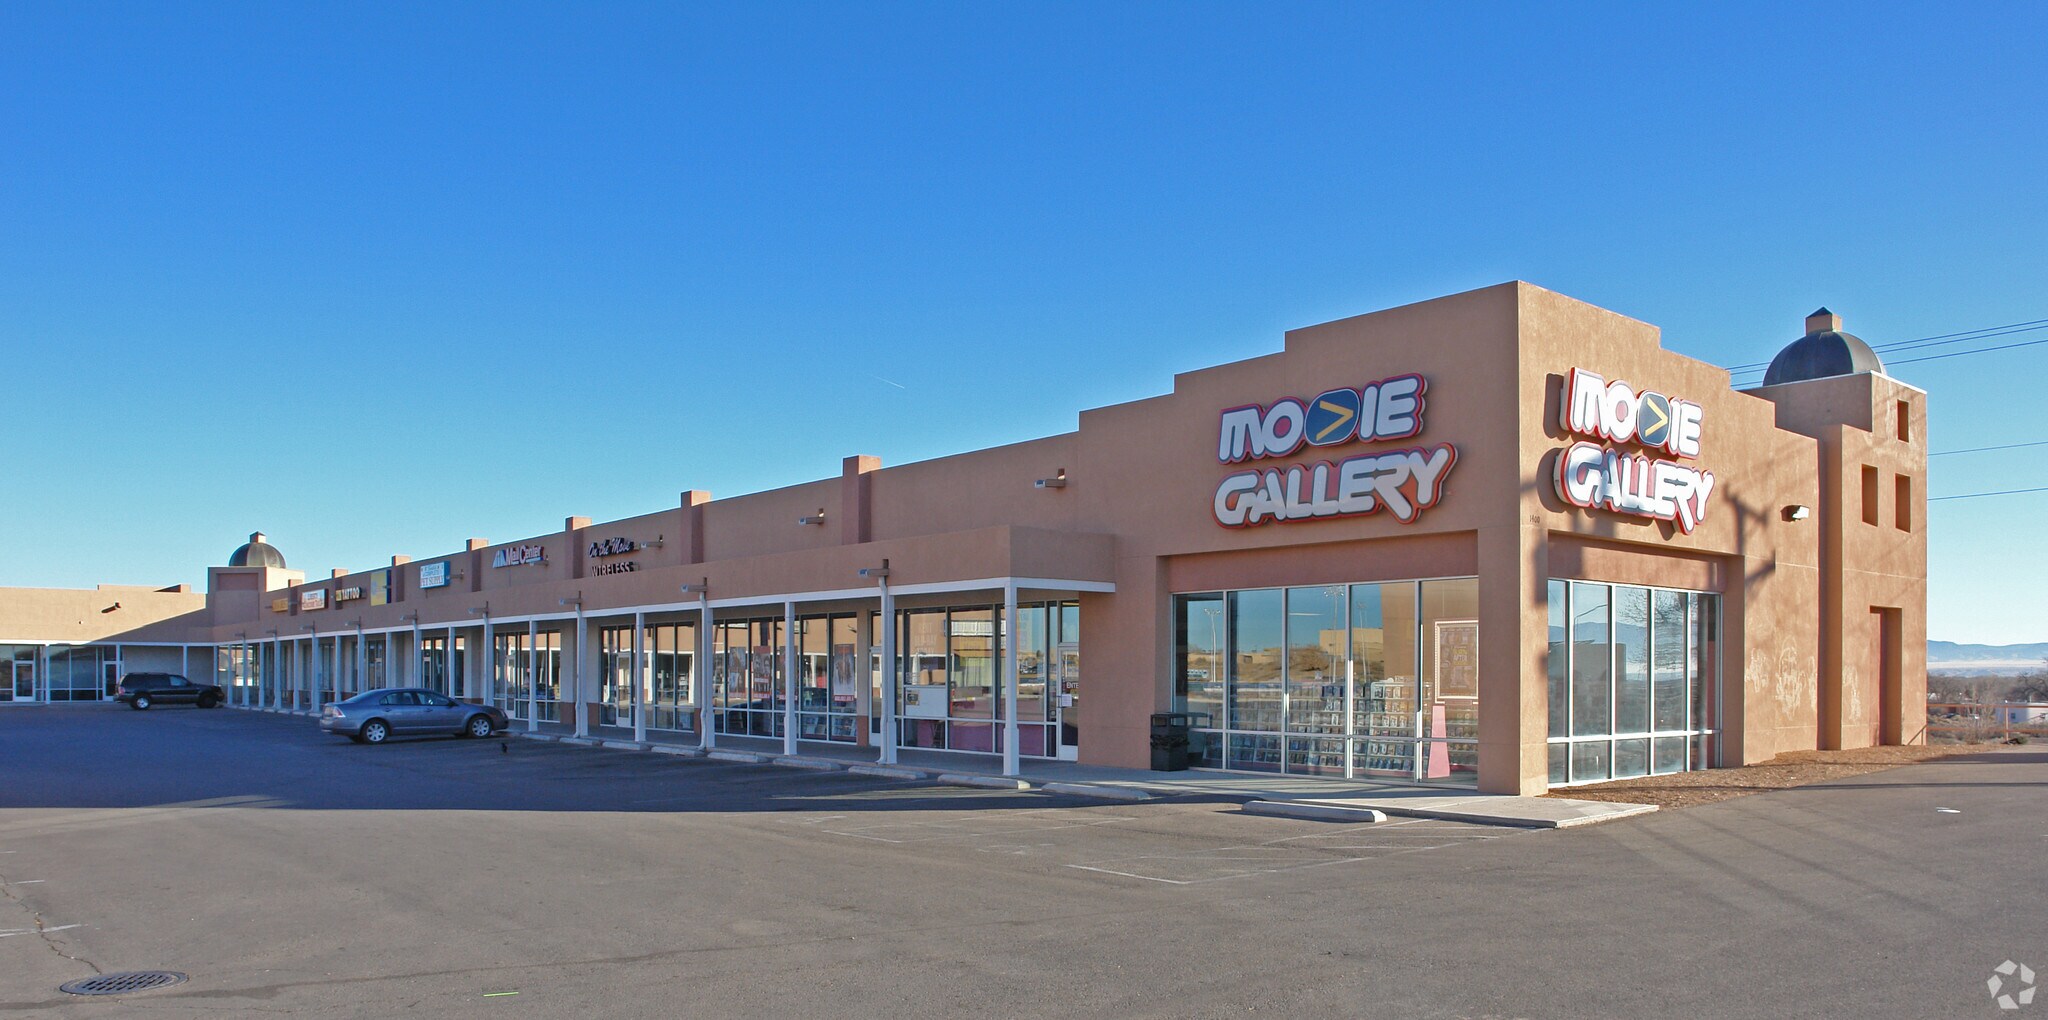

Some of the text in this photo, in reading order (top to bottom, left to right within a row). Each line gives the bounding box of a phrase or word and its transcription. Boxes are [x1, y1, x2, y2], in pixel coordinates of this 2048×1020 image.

[1214, 446, 1453, 526] GALLERY
[1566, 443, 1714, 533] GALLERY
[506, 545, 543, 565] Mail Center
[588, 542, 599, 558] On
[611, 537, 634, 554] Move
[591, 561, 633, 577] WIRELESS
[342, 587, 360, 600] TATTOO
